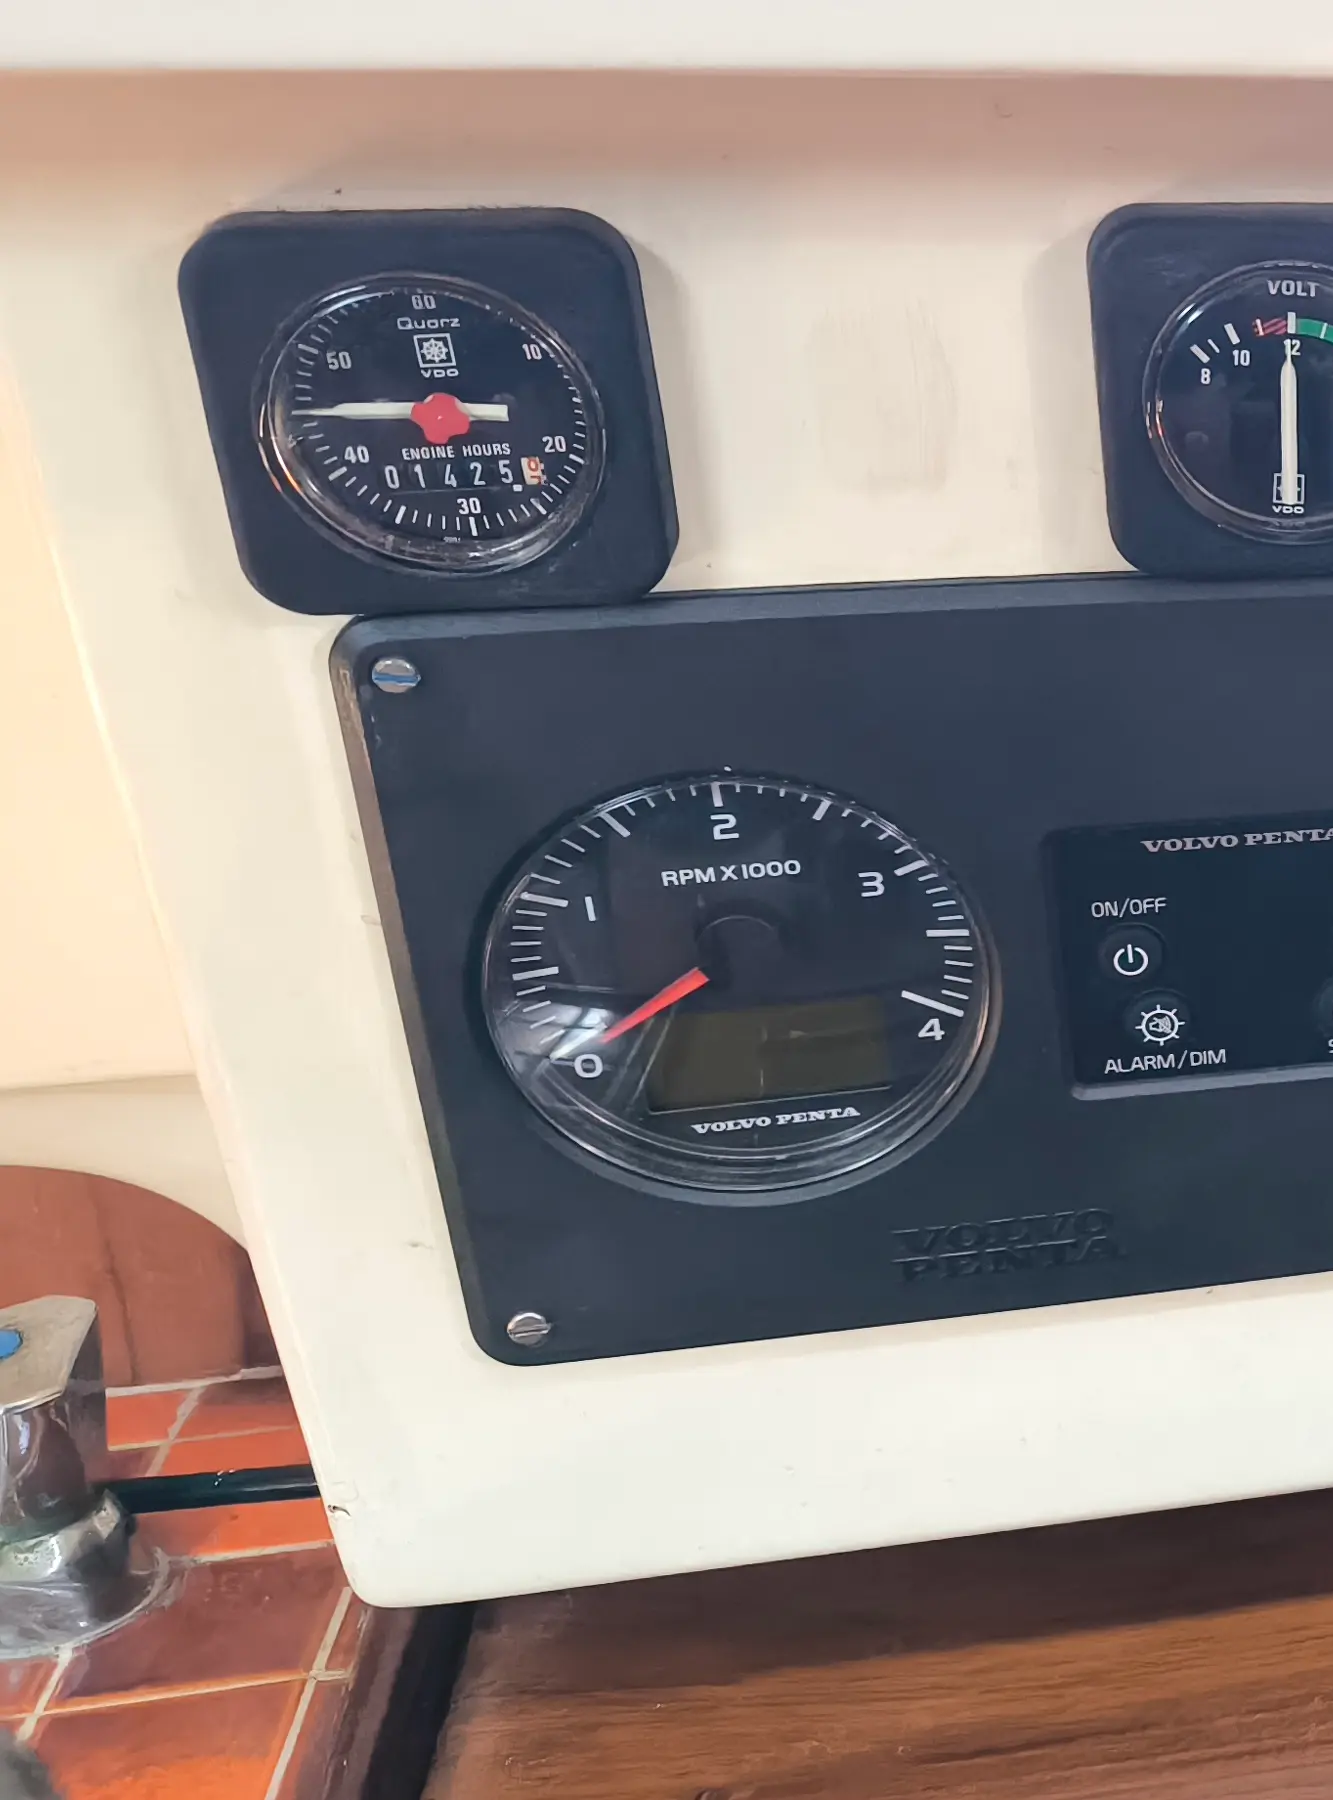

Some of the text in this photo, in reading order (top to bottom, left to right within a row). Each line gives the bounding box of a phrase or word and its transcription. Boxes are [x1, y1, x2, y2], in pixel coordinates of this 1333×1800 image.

[1267, 280, 1320, 298] VOLT
[522, 342, 542, 361] 10
[1283, 339, 1301, 357] 12
[326, 351, 352, 371] 50
[1232, 350, 1251, 367] 10
[420, 368, 460, 378] VDO
[1200, 368, 1211, 385] 8
[402, 443, 511, 461] ENGINE HOURS
[542, 435, 567, 454] 20
[344, 445, 369, 464] 40
[457, 497, 482, 515] 30
[1272, 505, 1304, 514] VDO
[710, 814, 740, 840] 2
[1140, 834, 1239, 853] VOLVO
[661, 867, 717, 887] RPM
[858, 872, 885, 897] 3
[584, 896, 597, 922] 1
[1090, 897, 1167, 918] ON/OFF
[917, 1018, 946, 1042] 4
[573, 1053, 603, 1079] 0
[691, 1106, 861, 1134] VOLVO PENTA
